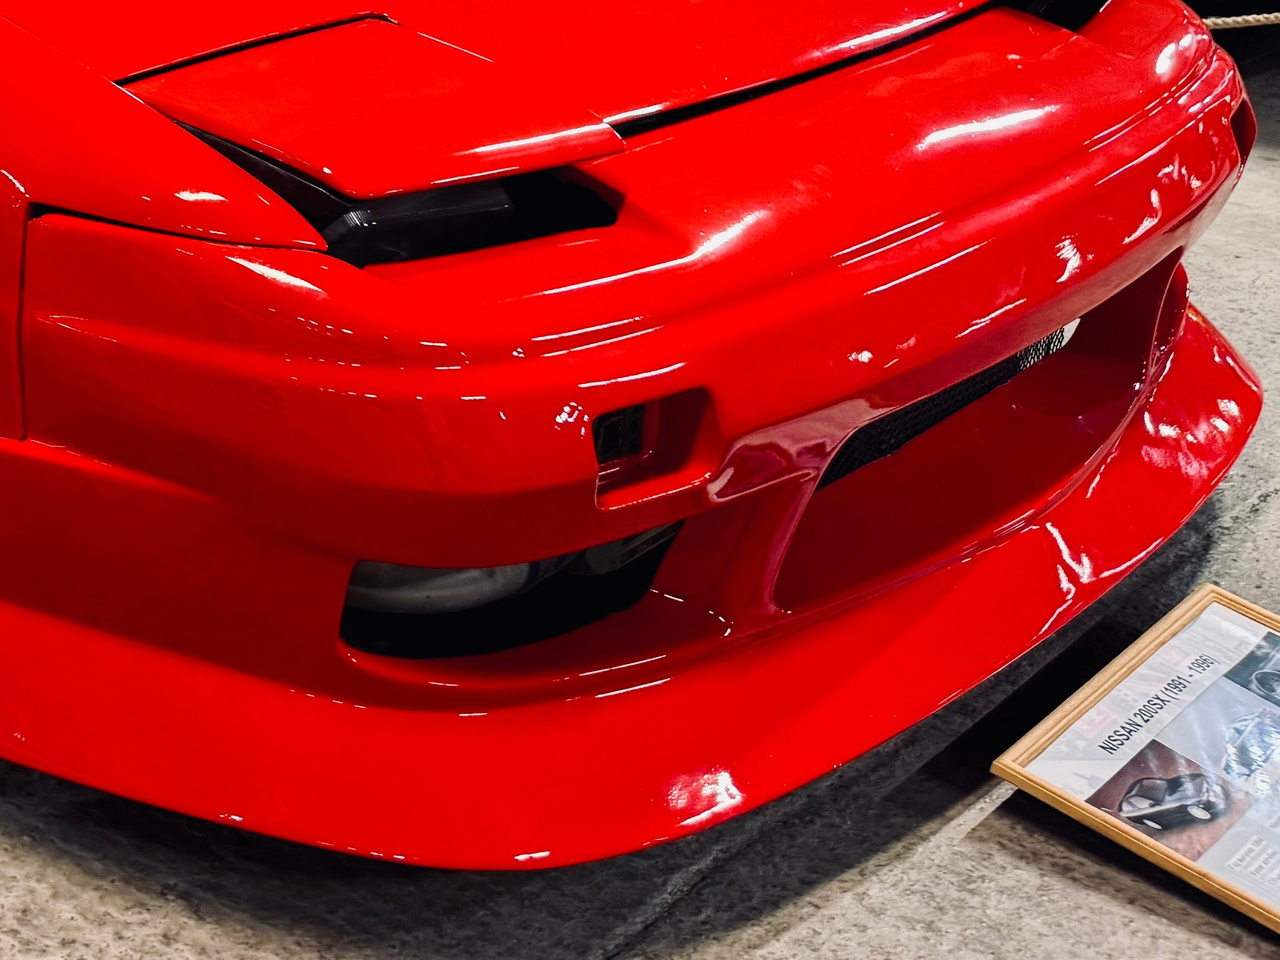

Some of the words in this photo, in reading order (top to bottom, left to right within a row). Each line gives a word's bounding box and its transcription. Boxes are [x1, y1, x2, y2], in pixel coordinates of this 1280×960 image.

[1098, 718, 1144, 755] NISSAN
[1133, 694, 1171, 724] 200SX
[1160, 675, 1192, 700] (1991
[1187, 653, 1221, 674] 1996)
